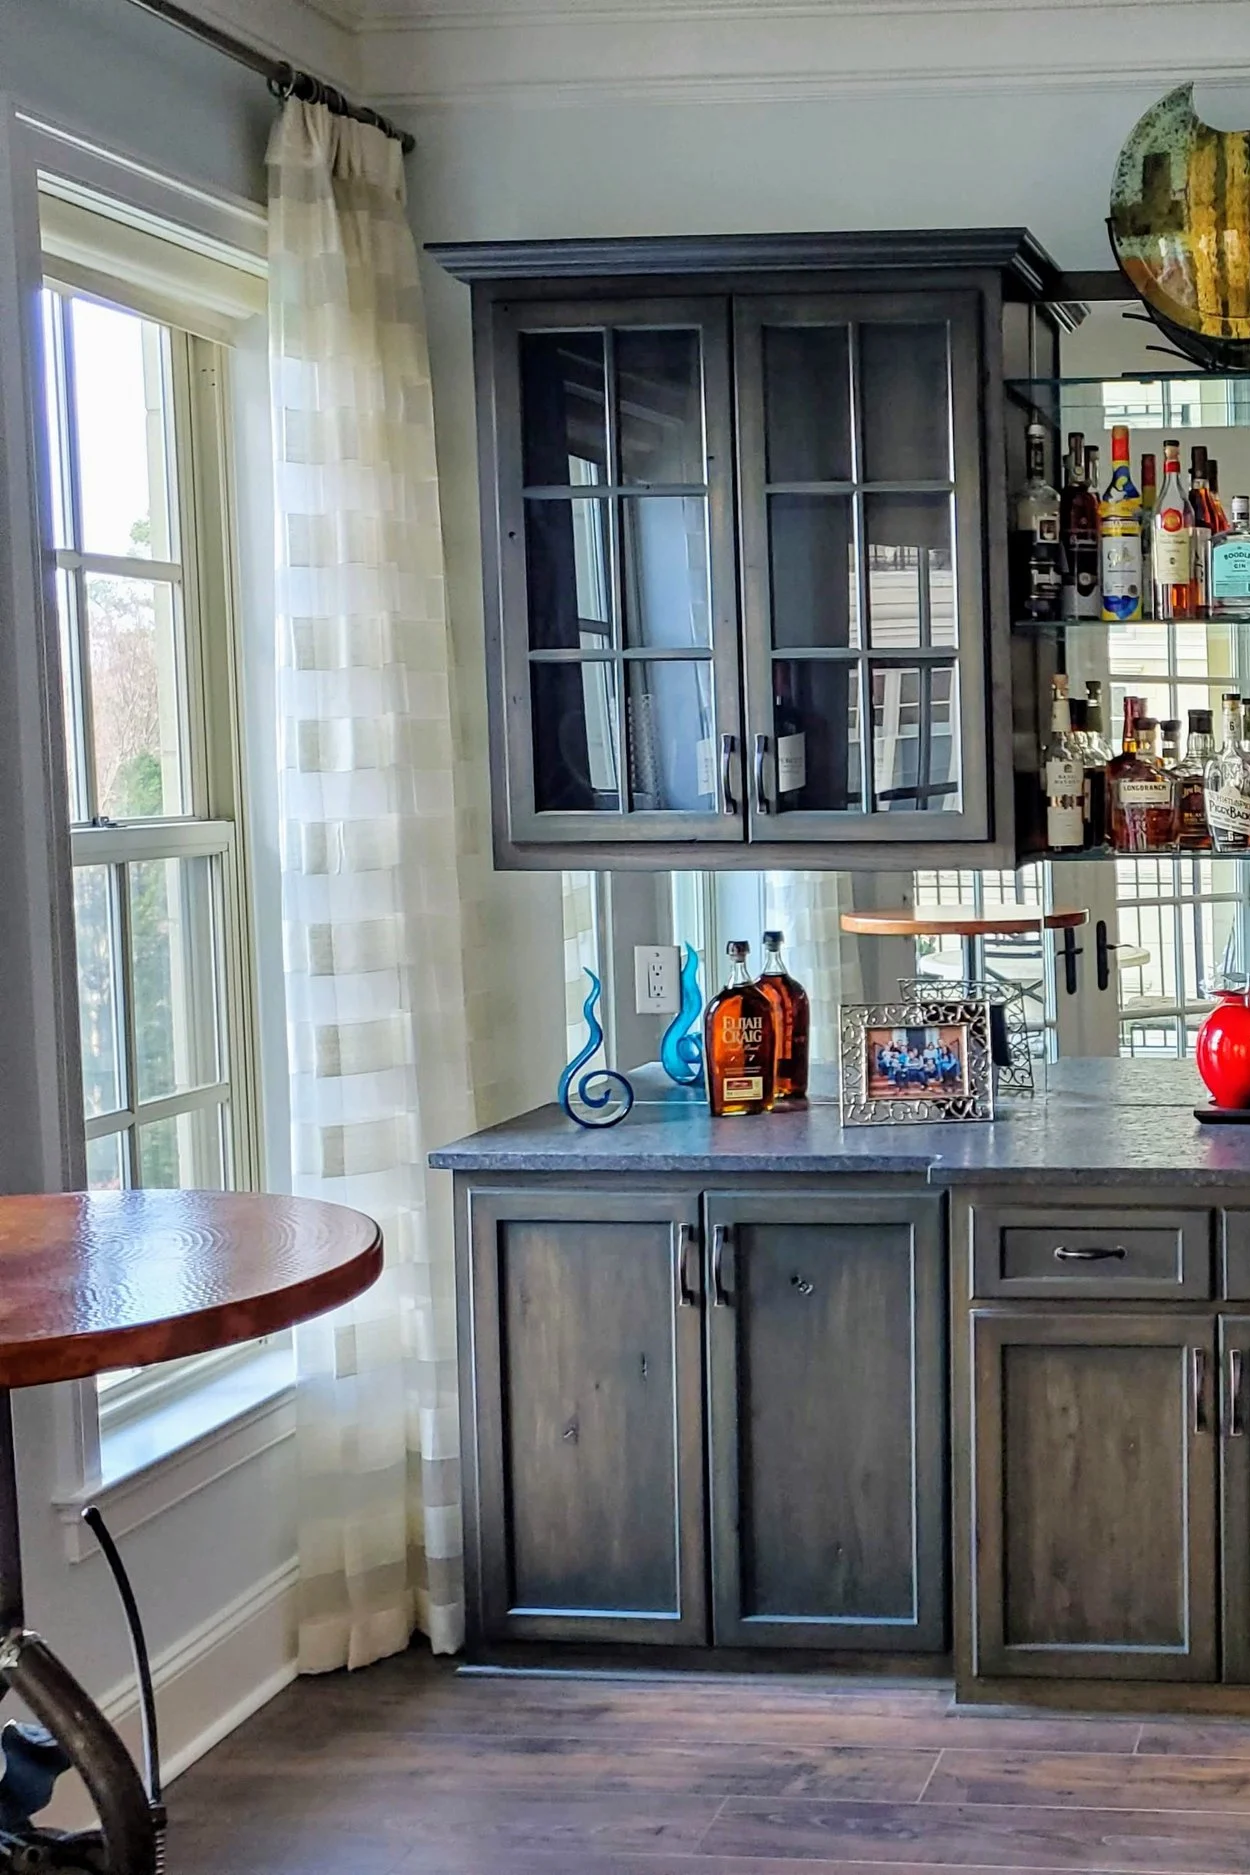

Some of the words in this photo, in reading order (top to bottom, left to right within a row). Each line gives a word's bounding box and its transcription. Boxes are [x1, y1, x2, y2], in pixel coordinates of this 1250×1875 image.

[1230, 721, 1235, 731] 6
[722, 1016, 763, 1031] ELIJAH
[722, 1030, 763, 1044] CRAIG
